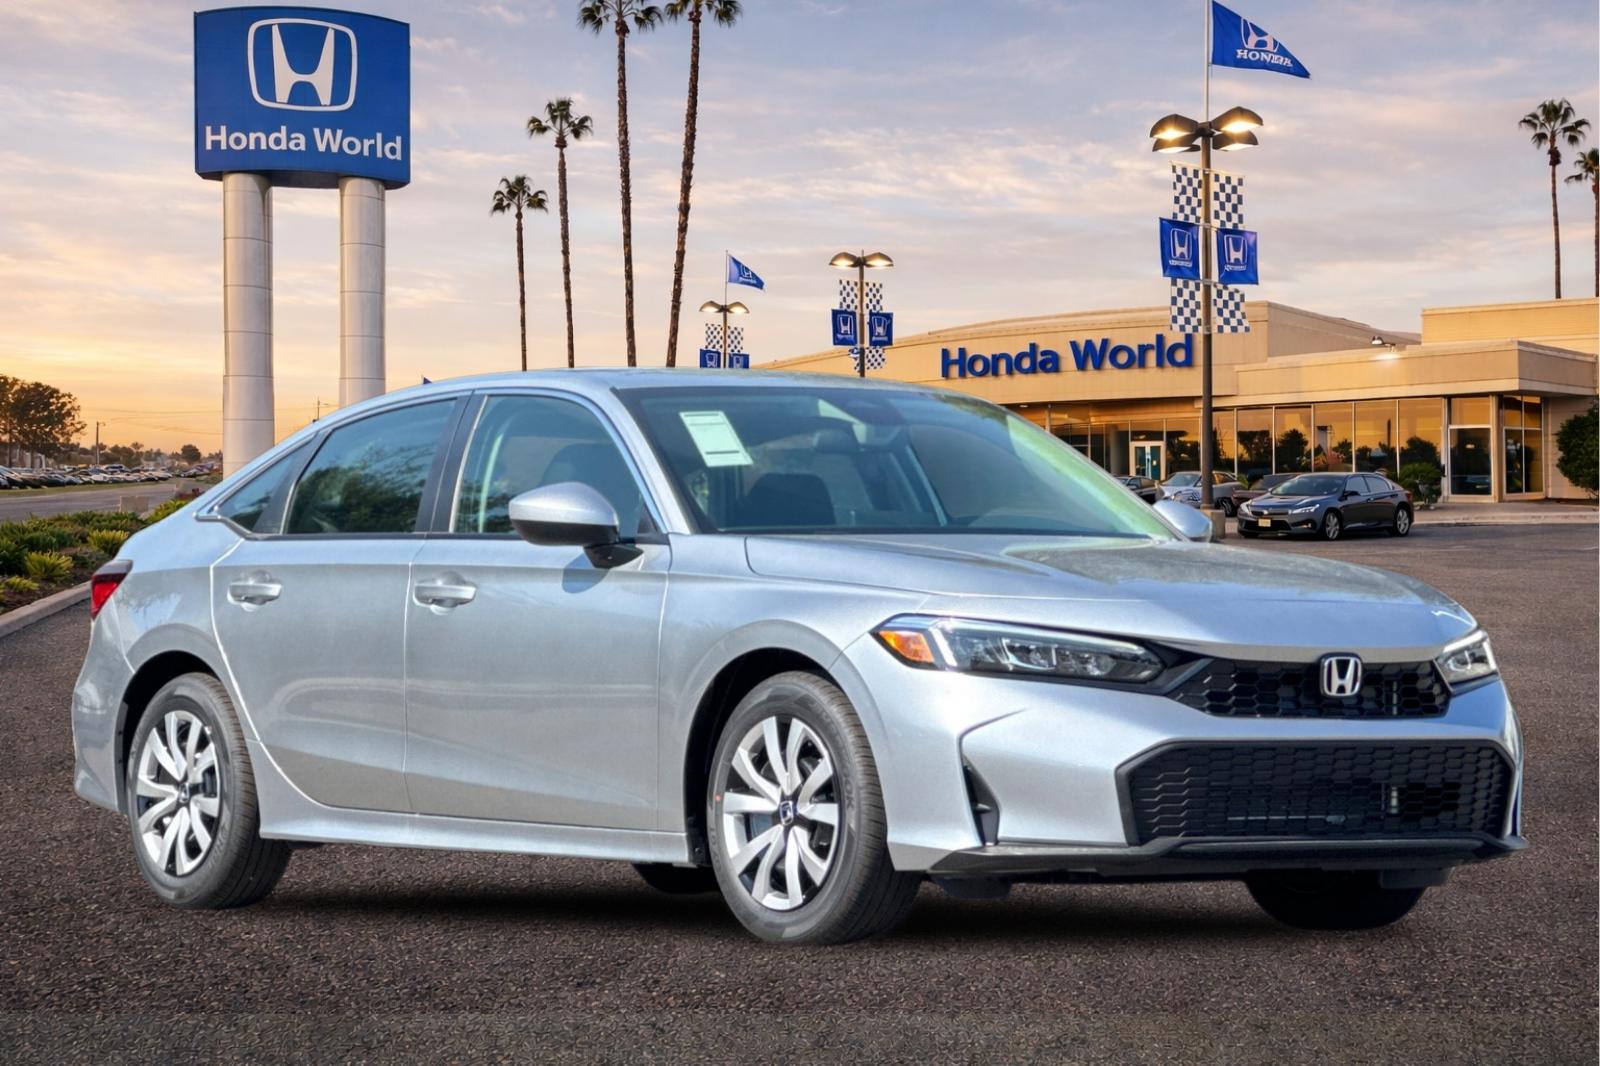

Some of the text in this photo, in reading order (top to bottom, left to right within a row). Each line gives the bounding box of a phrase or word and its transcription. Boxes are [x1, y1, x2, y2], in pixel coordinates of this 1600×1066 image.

[205, 125, 402, 161] Honda World
[941, 333, 1195, 379] Honda World
